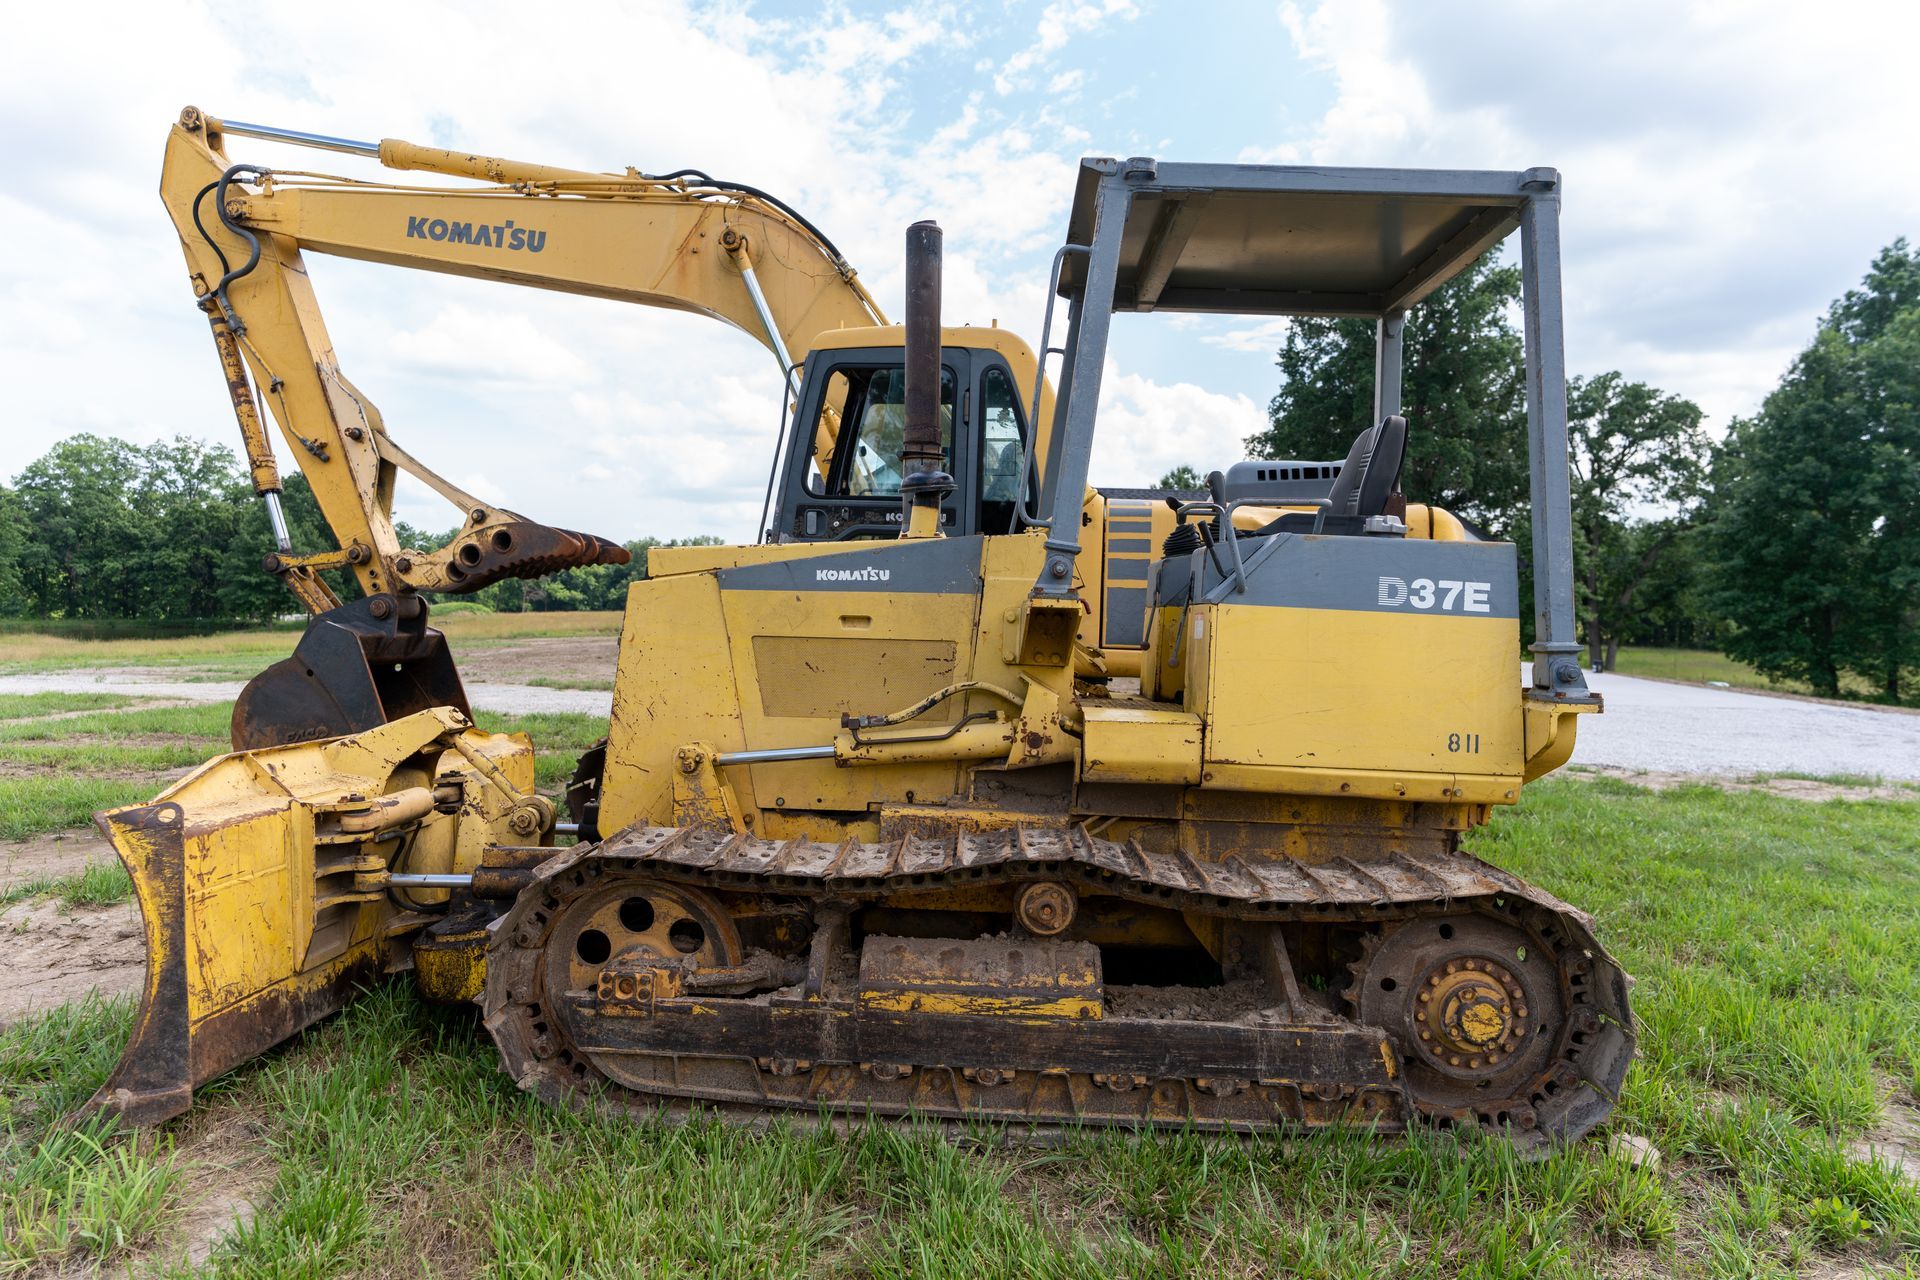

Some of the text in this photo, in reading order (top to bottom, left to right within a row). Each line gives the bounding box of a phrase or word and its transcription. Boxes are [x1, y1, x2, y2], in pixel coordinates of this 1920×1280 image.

[406, 216, 547, 253] KOMATSU
[816, 566, 890, 581] KOMATSU
[1378, 576, 1491, 612] D37E
[1448, 733, 1479, 754] 811
